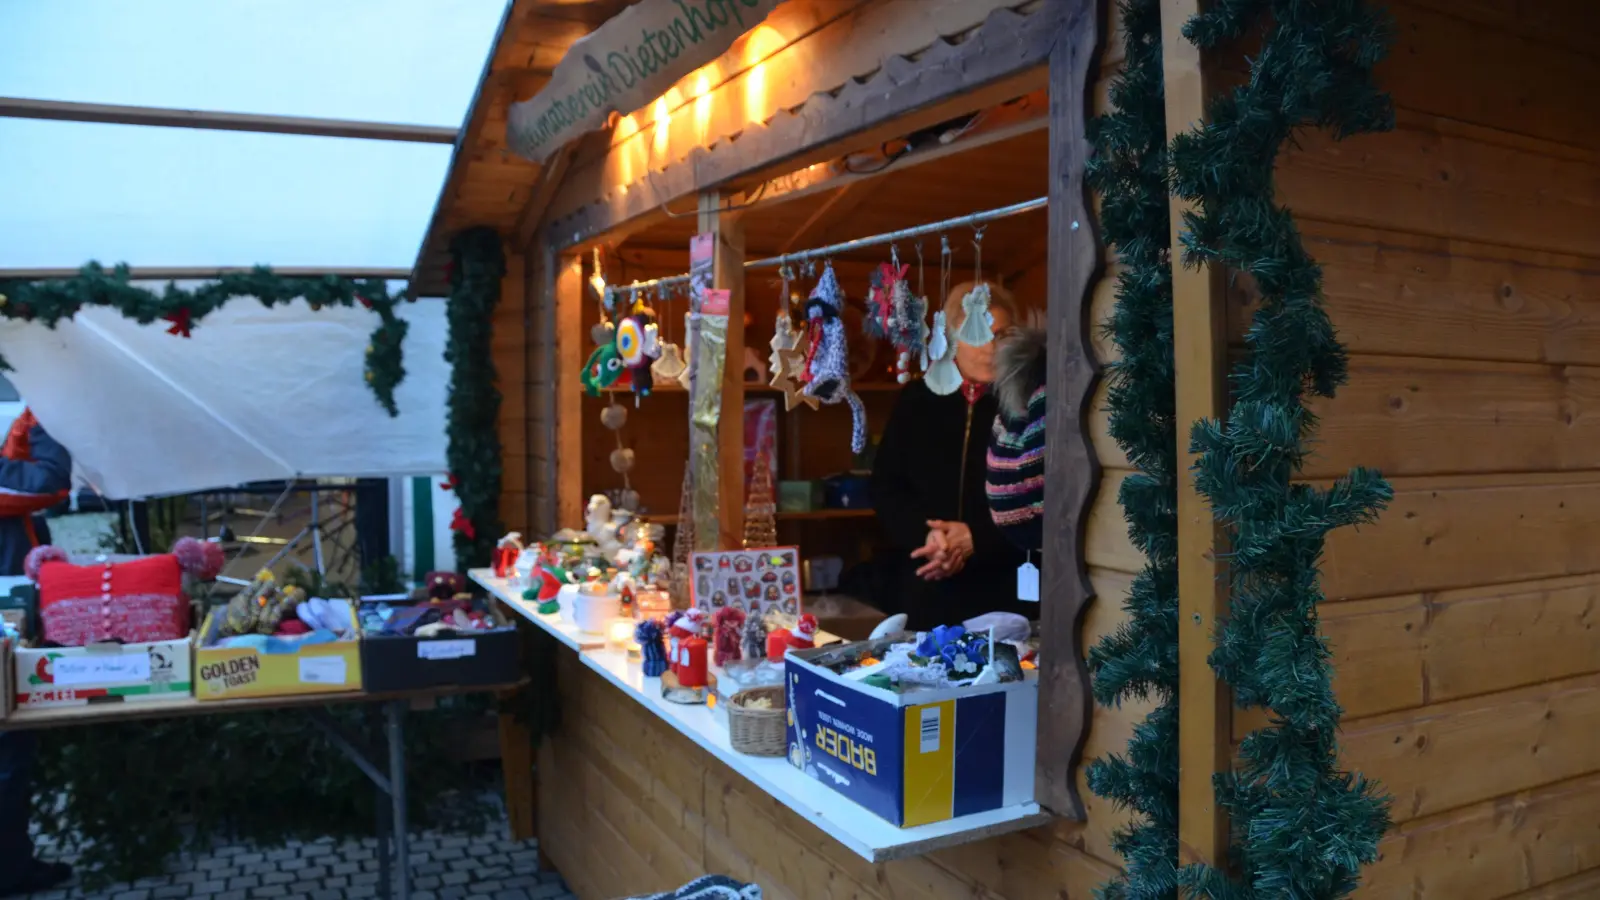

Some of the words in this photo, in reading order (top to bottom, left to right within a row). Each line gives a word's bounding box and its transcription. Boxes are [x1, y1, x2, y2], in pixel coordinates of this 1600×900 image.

[200, 655, 260, 682] GOLDEN
[223, 671, 258, 689] TOAST
[815, 723, 877, 776] BADER
